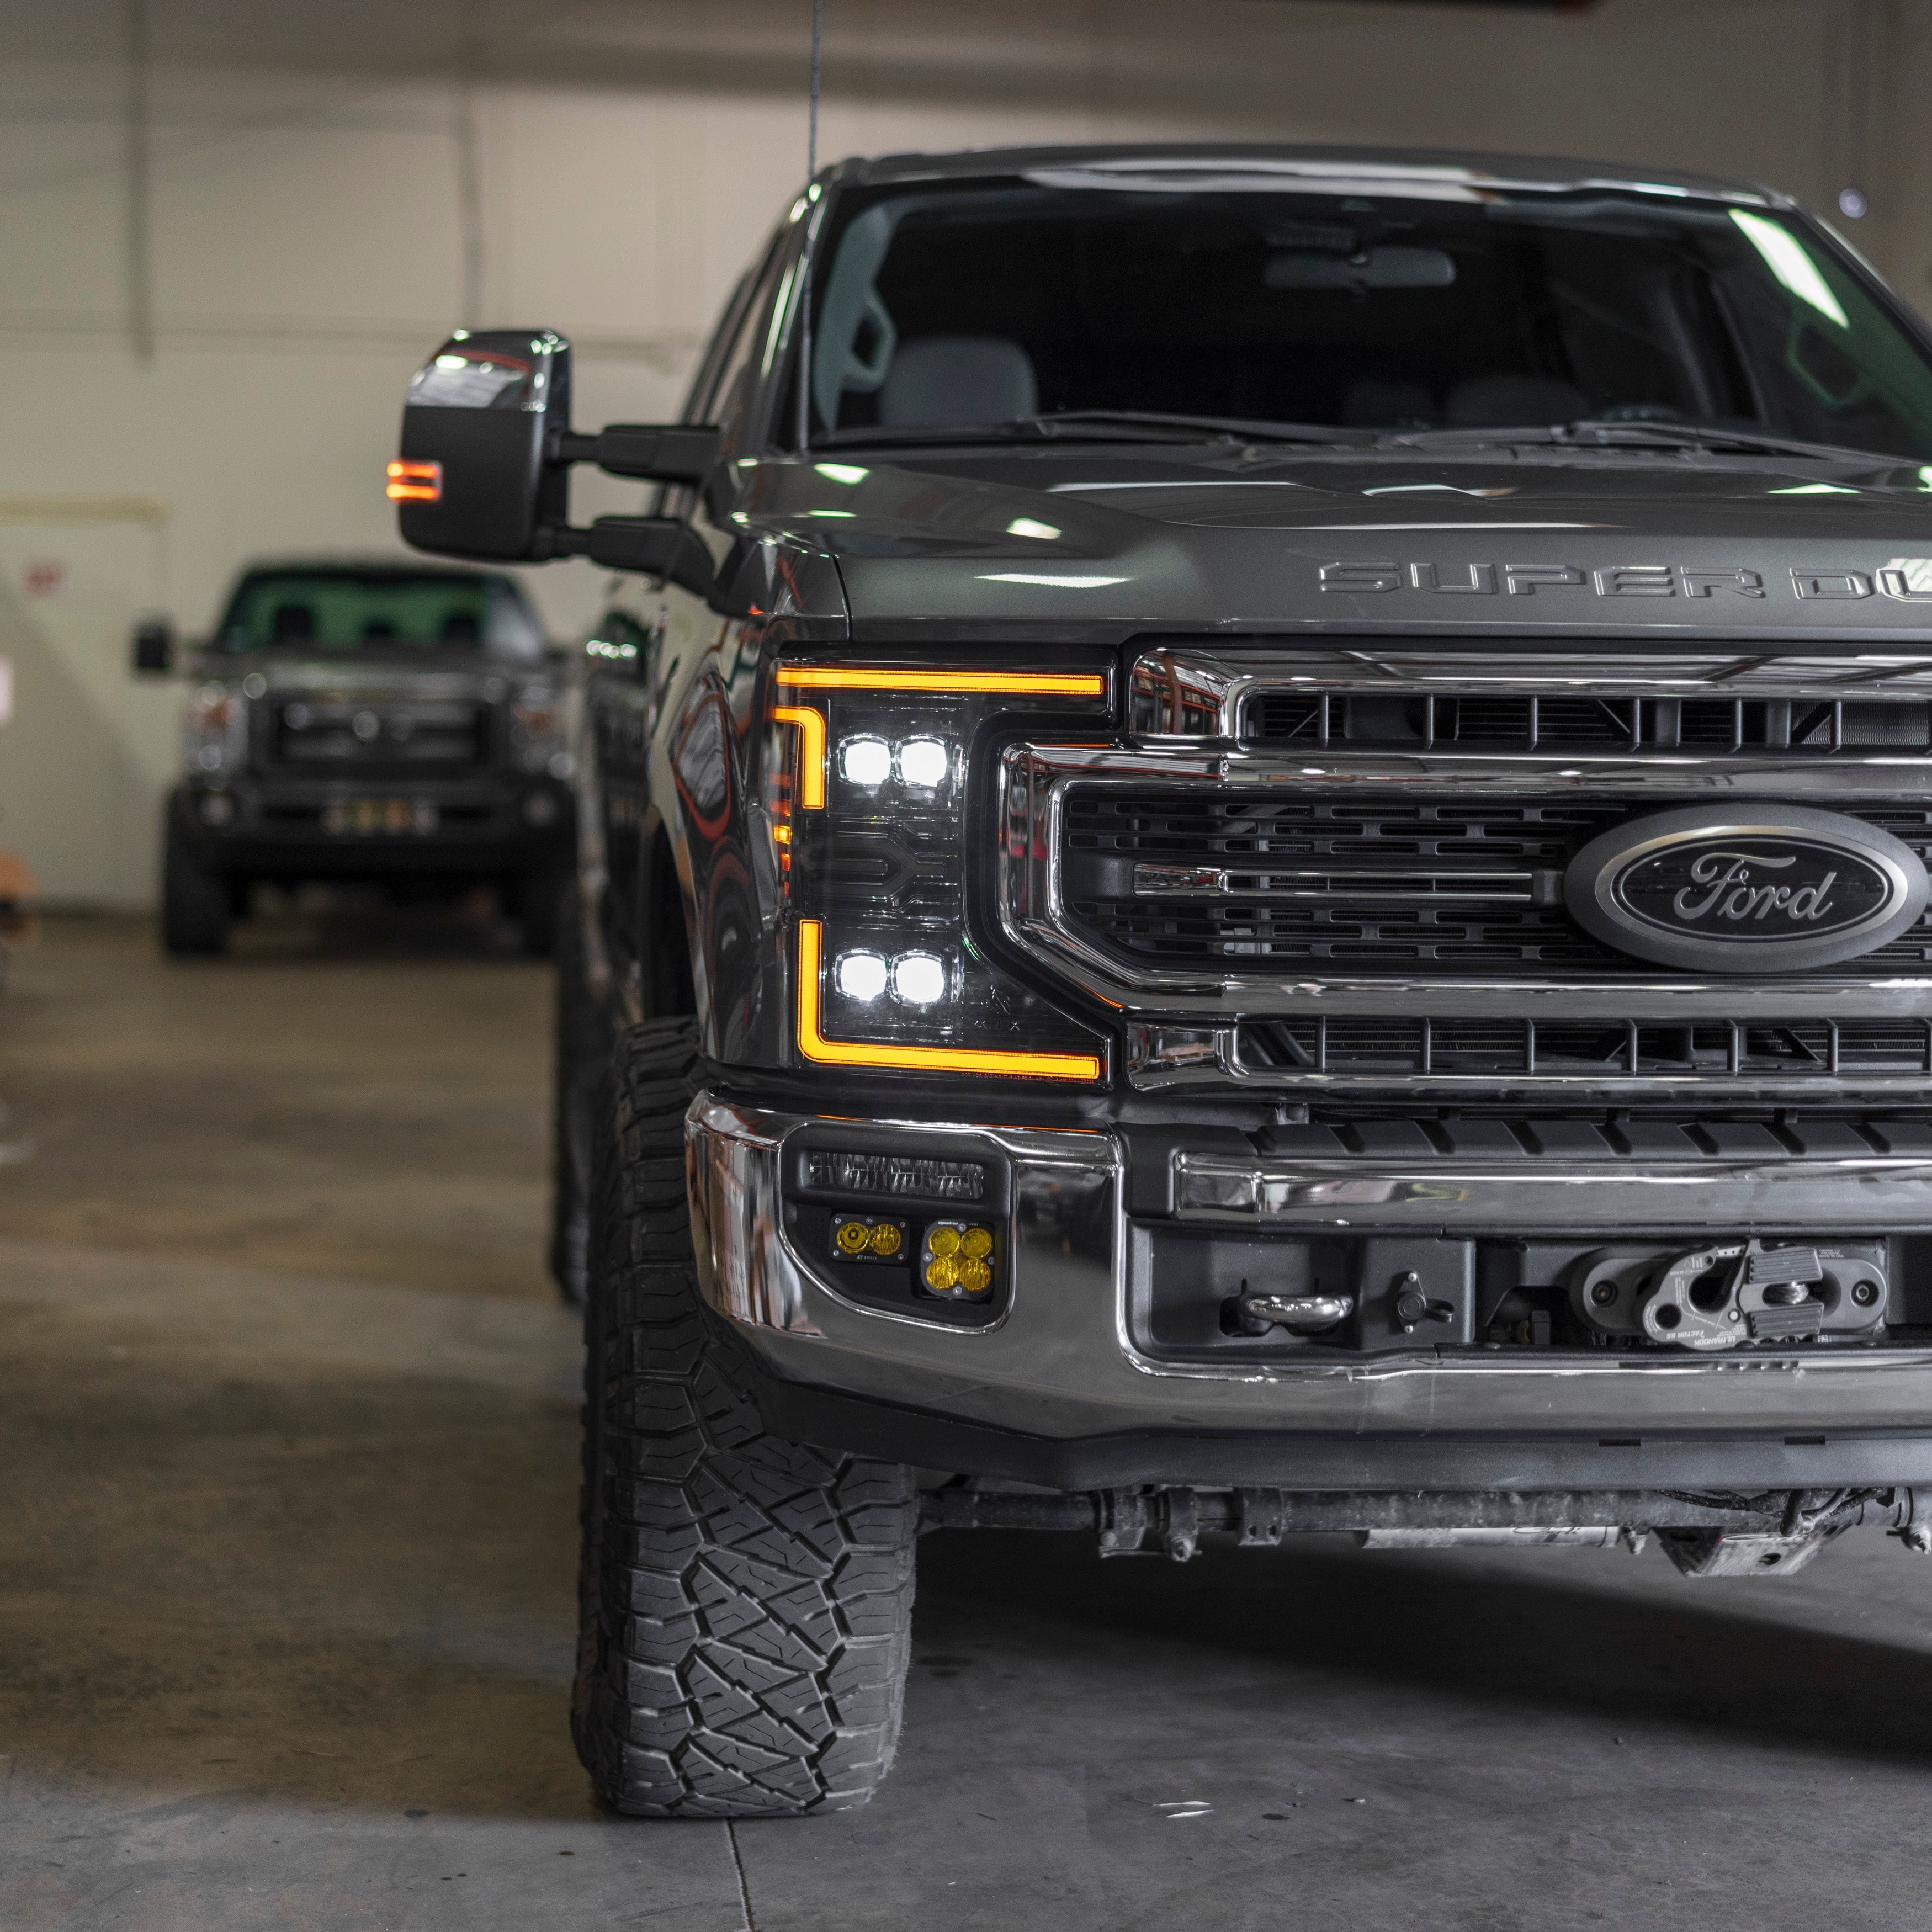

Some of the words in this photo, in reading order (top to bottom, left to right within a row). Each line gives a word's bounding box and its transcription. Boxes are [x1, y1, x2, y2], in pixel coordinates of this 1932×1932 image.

[1319, 562, 1766, 599] SUPER
[1673, 852, 1837, 920] Ford
[1677, 1330, 1704, 1339] FACTOR
[1693, 1335, 1736, 1346] ULTRAHOOK
